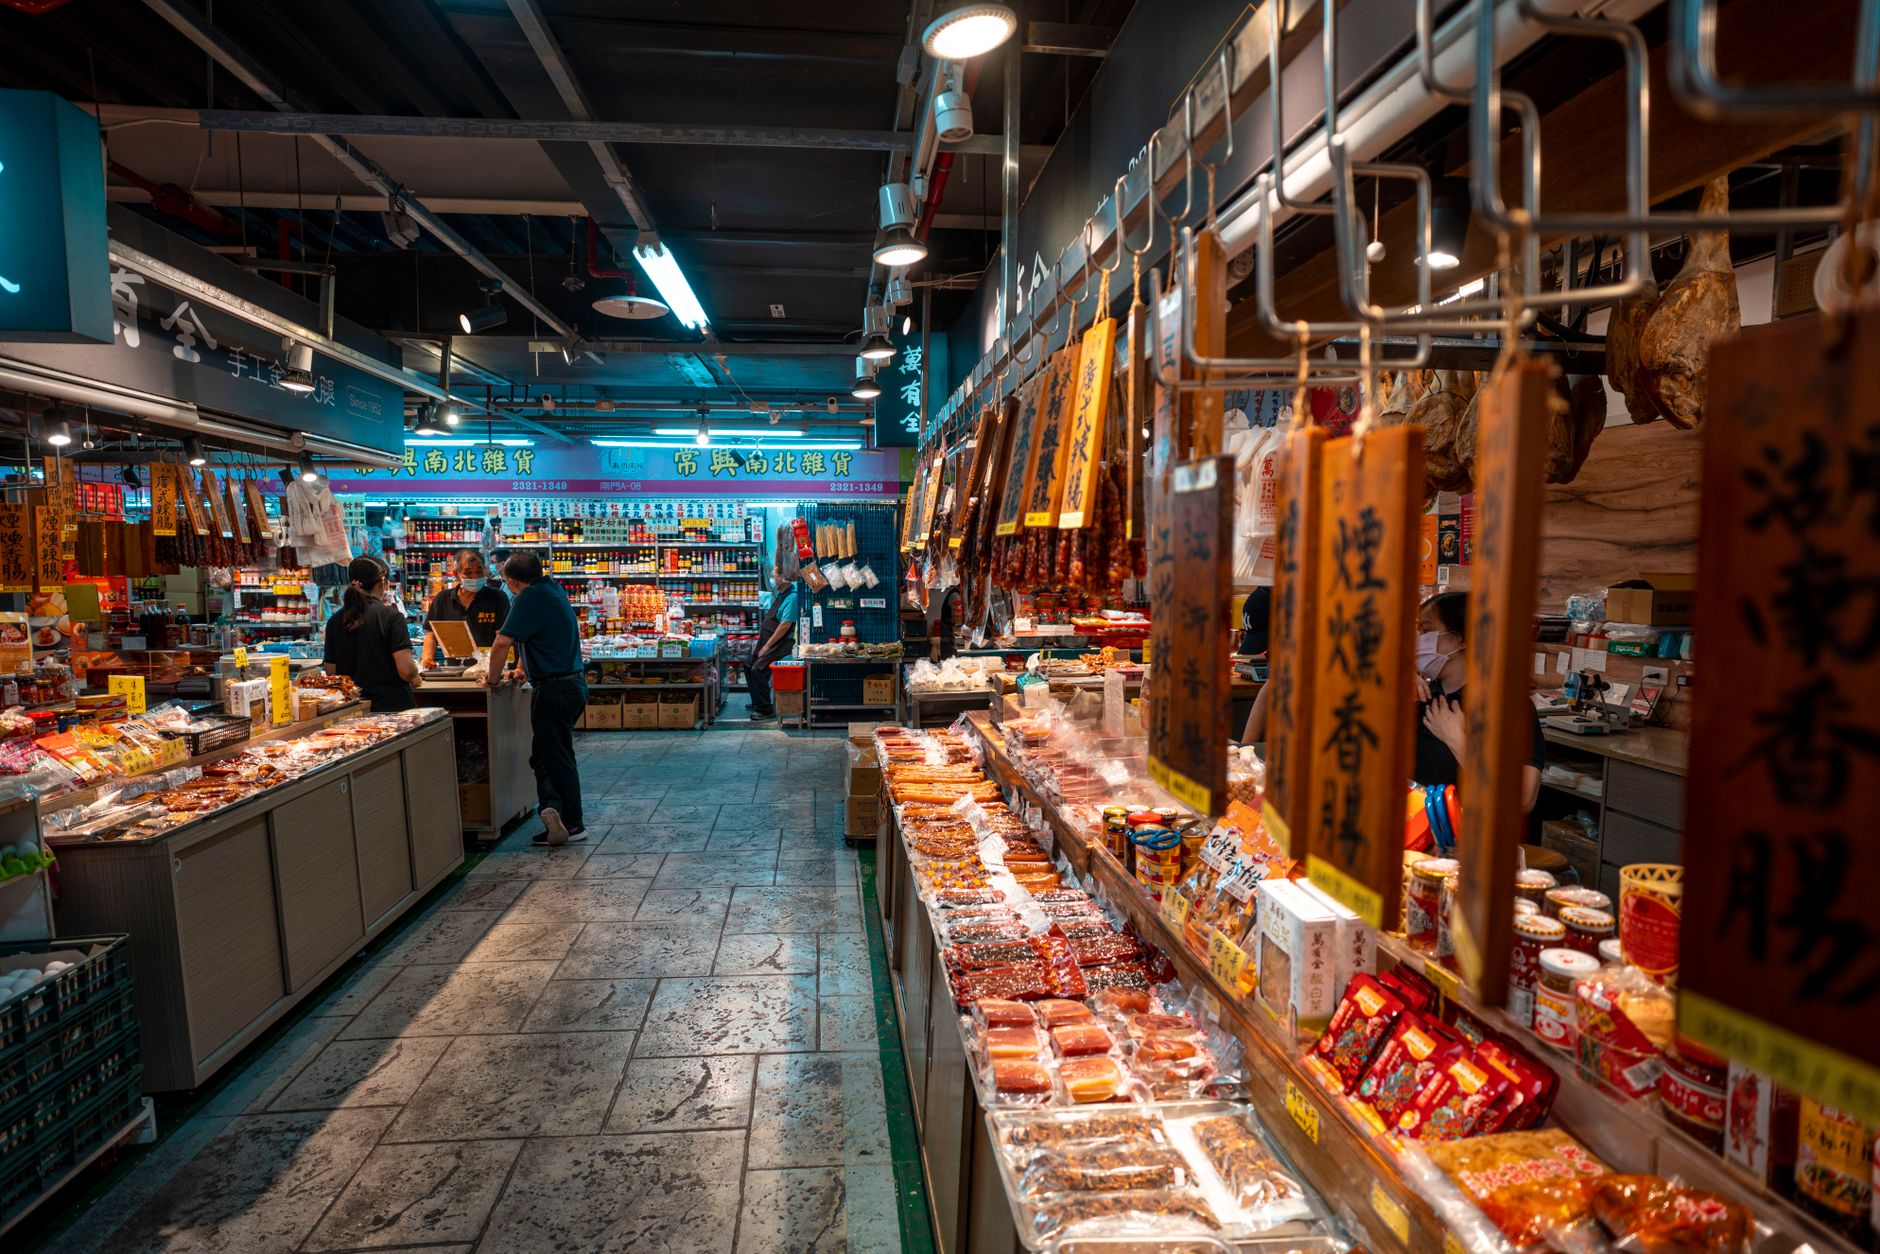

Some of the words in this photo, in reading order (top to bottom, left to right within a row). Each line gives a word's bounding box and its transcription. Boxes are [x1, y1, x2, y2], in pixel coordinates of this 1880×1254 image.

[898, 345, 922, 433] 萬有全
[673, 447, 853, 477] 常興南北雜貨
[512, 481, 568, 491] 2321-1349
[830, 482, 883, 491] 2321-1349
[1311, 931, 1324, 970] 萬有全
[1351, 929, 1366, 968] 萬有全
